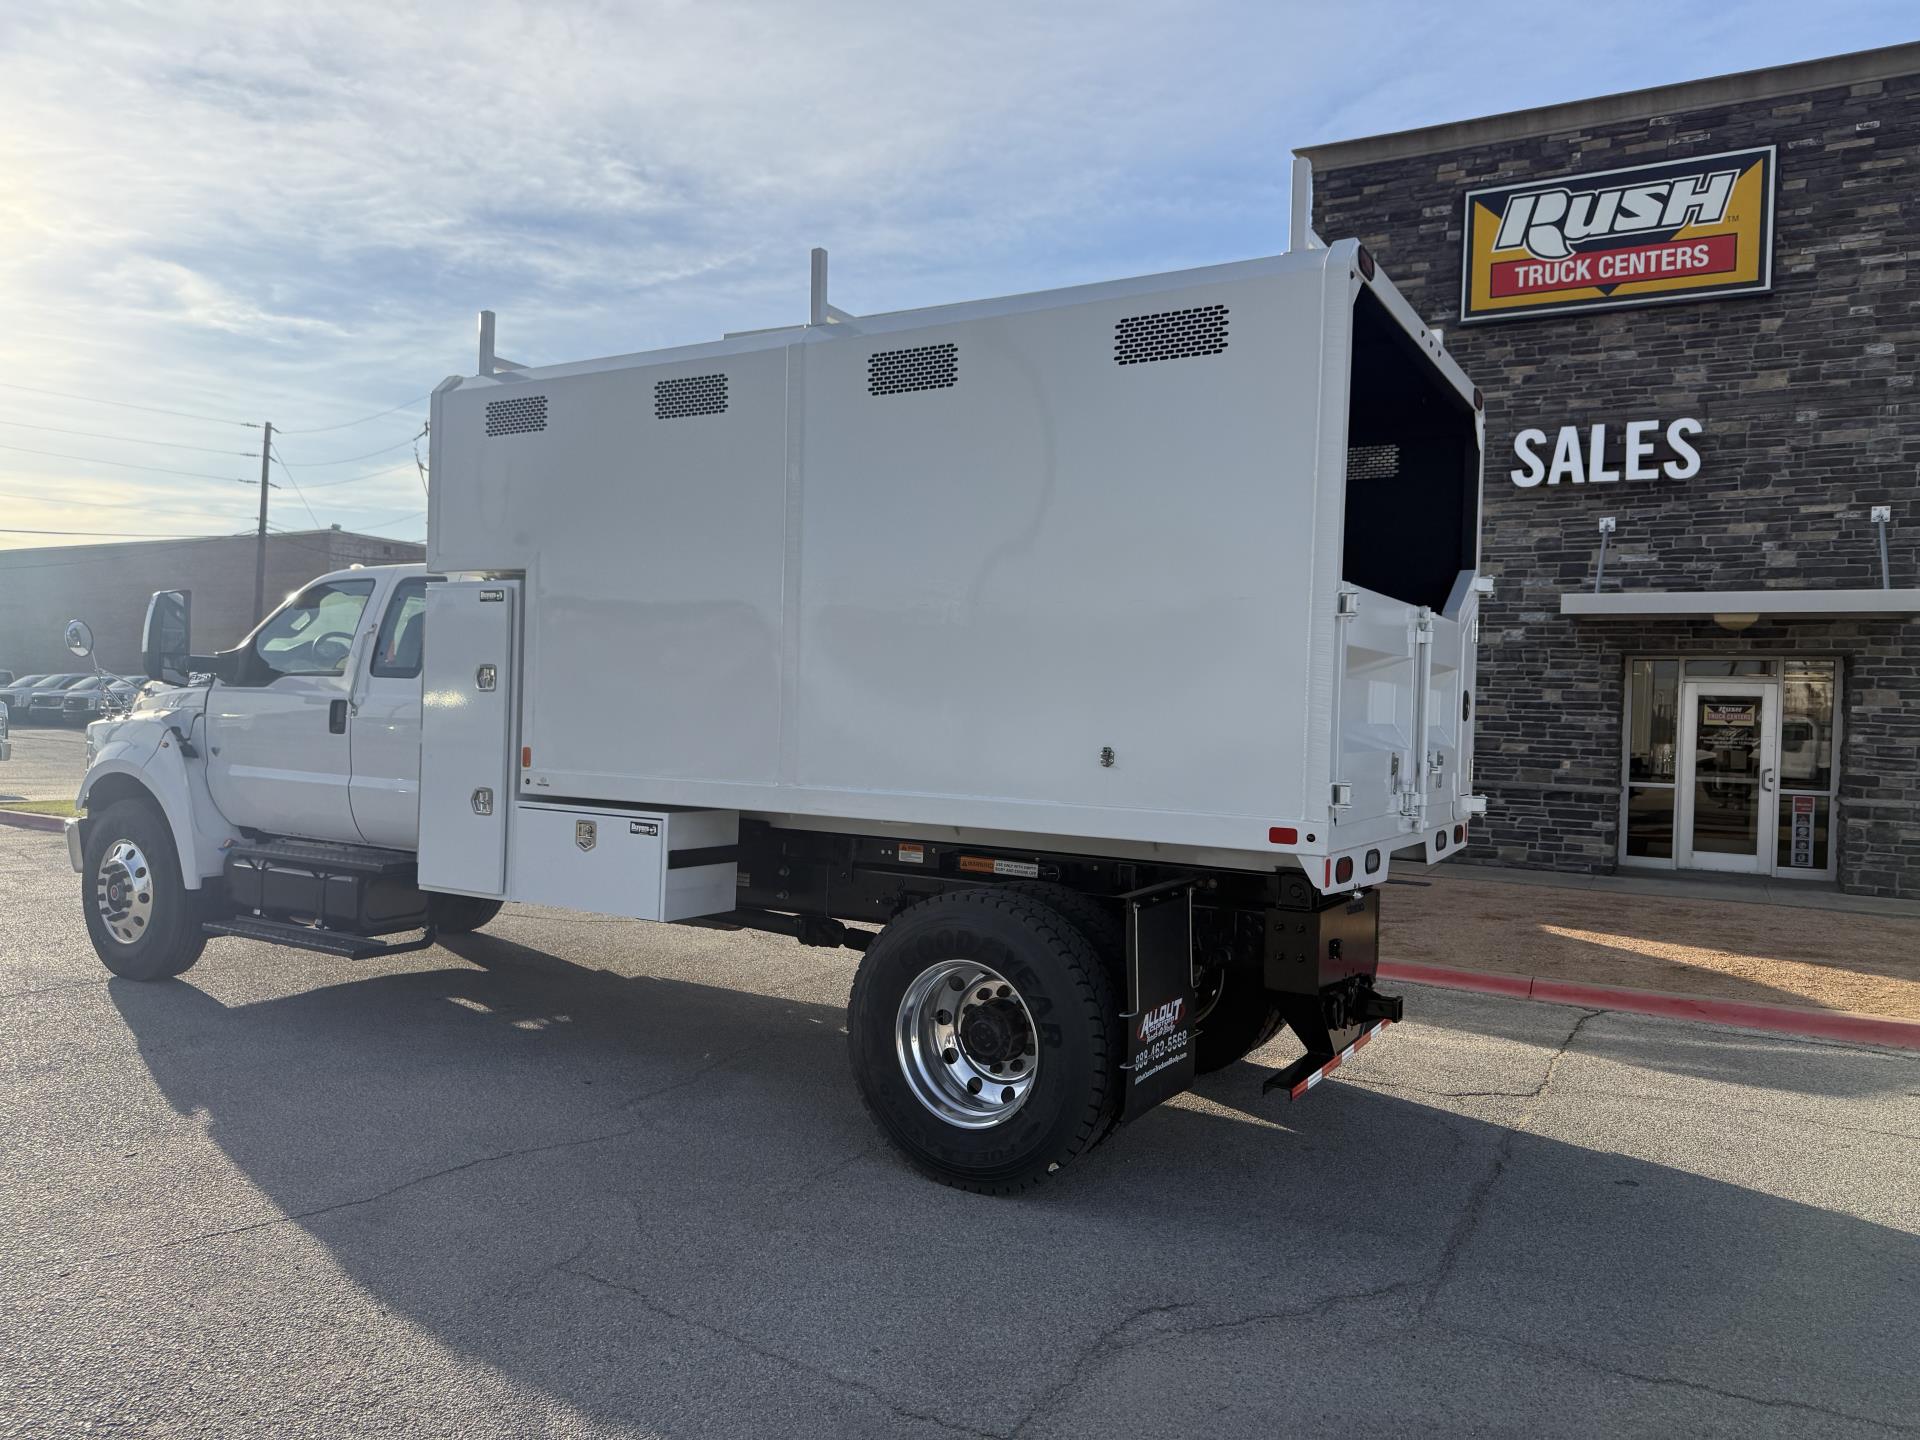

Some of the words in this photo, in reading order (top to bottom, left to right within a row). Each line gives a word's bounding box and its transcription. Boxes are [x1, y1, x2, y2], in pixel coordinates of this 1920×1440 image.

[1514, 258, 1592, 288] TRUCK
[1598, 244, 1710, 278] CENTERS
[1510, 417, 1703, 488] SALES
